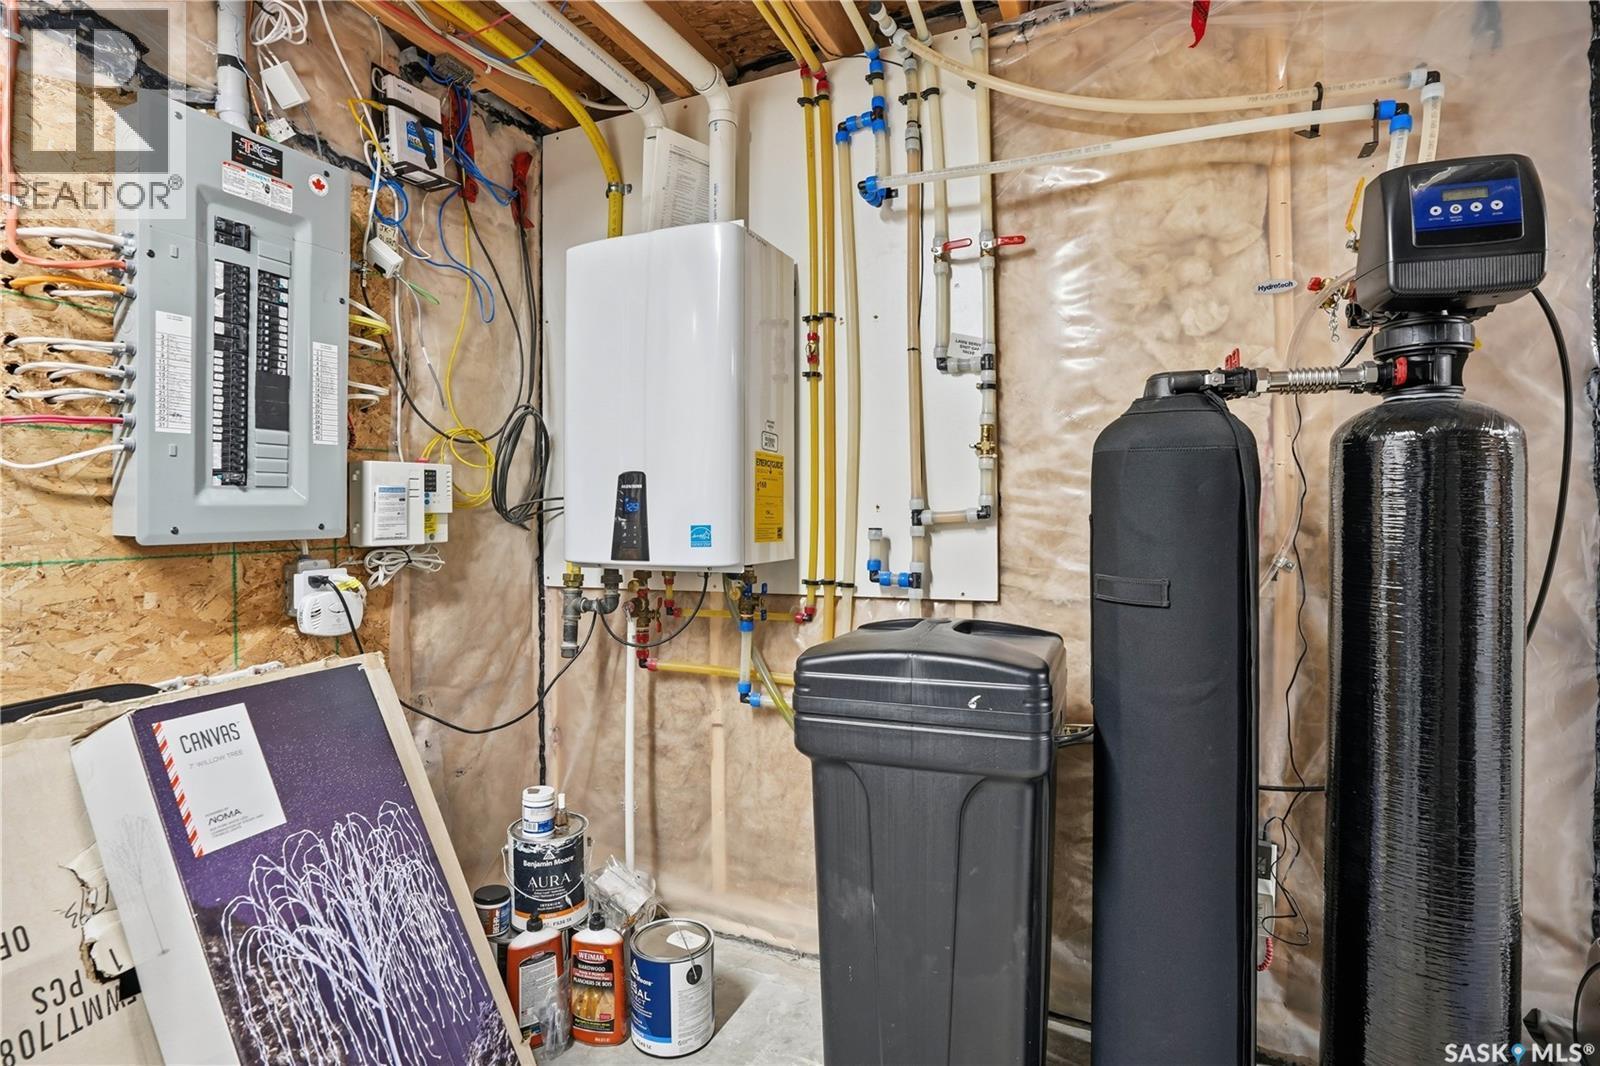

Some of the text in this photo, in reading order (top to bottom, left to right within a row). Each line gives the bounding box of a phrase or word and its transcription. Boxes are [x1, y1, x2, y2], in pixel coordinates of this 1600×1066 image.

[226, 749, 243, 759] TREE
[208, 809, 242, 825] NOMA
[523, 855, 573, 869] Benjamin Moore
[528, 872, 571, 888] AURA
[578, 952, 605, 961] WEIMAN
[32, 969, 84, 1015] PCS
